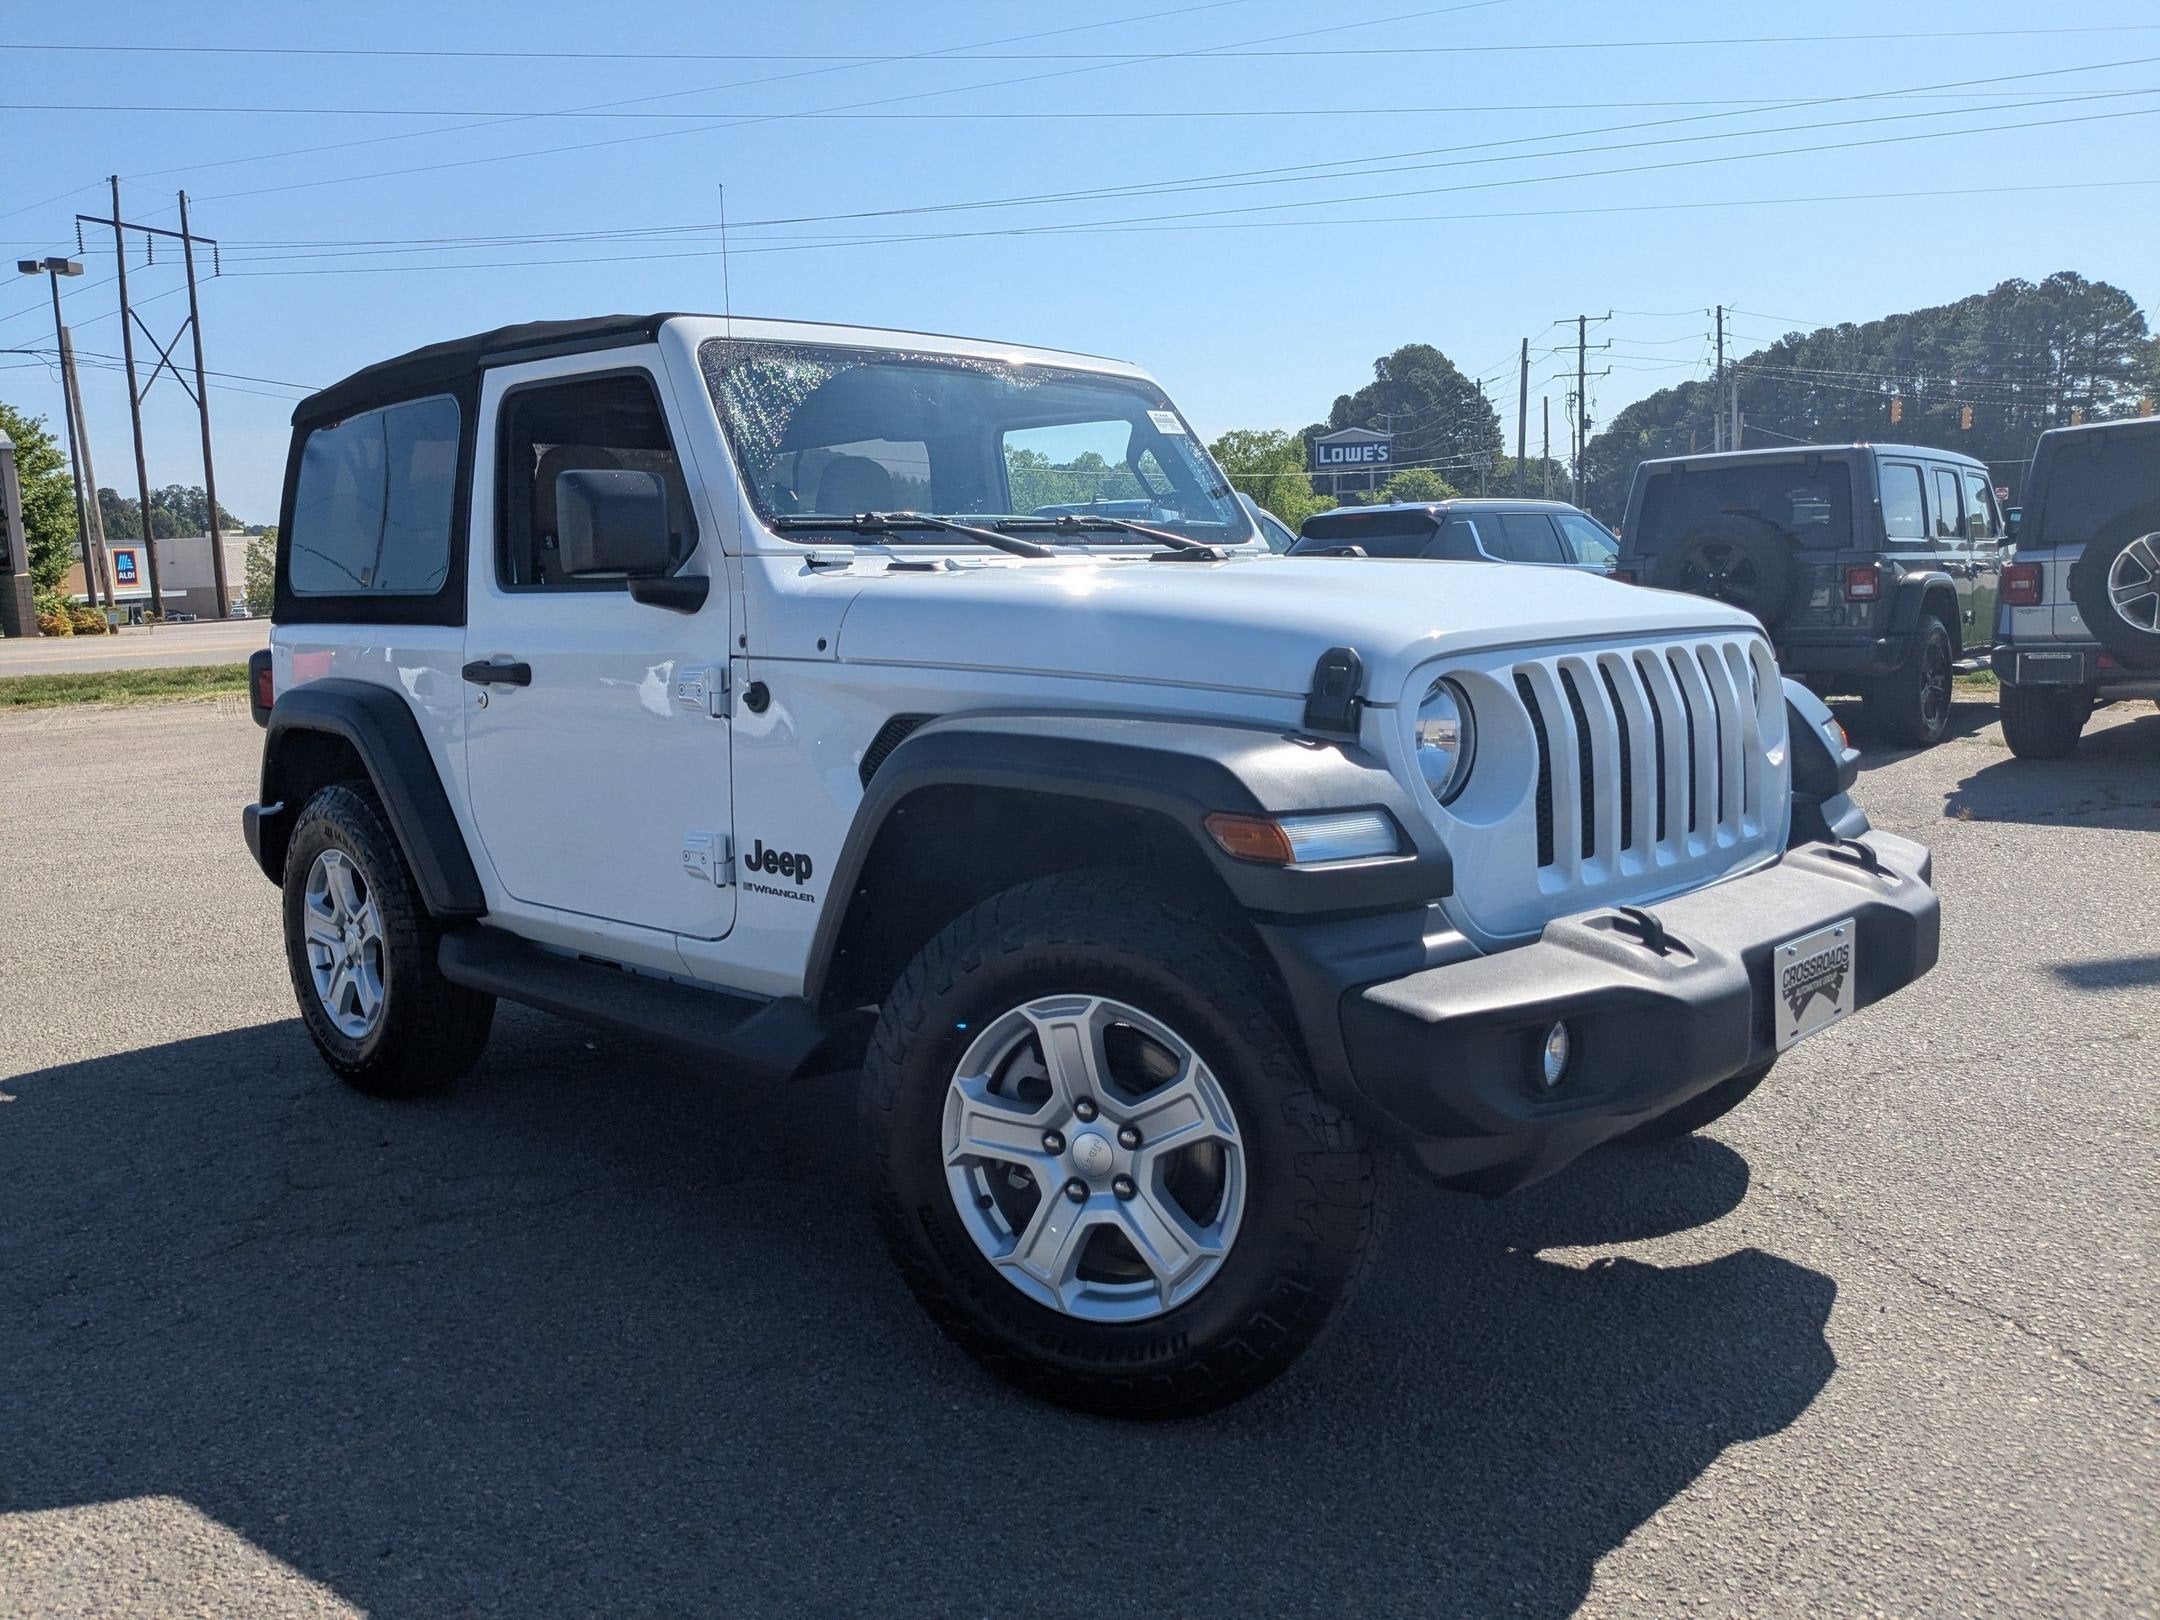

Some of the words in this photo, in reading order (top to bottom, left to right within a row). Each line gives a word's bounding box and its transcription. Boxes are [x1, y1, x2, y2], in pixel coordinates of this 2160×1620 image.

[1320, 444, 1389, 463] LOWE'S
[119, 571, 135, 579] ALDI
[744, 839, 812, 885] Jeep
[753, 883, 815, 903] WRANGLER
[1782, 943, 1850, 988] CROSSROADS
